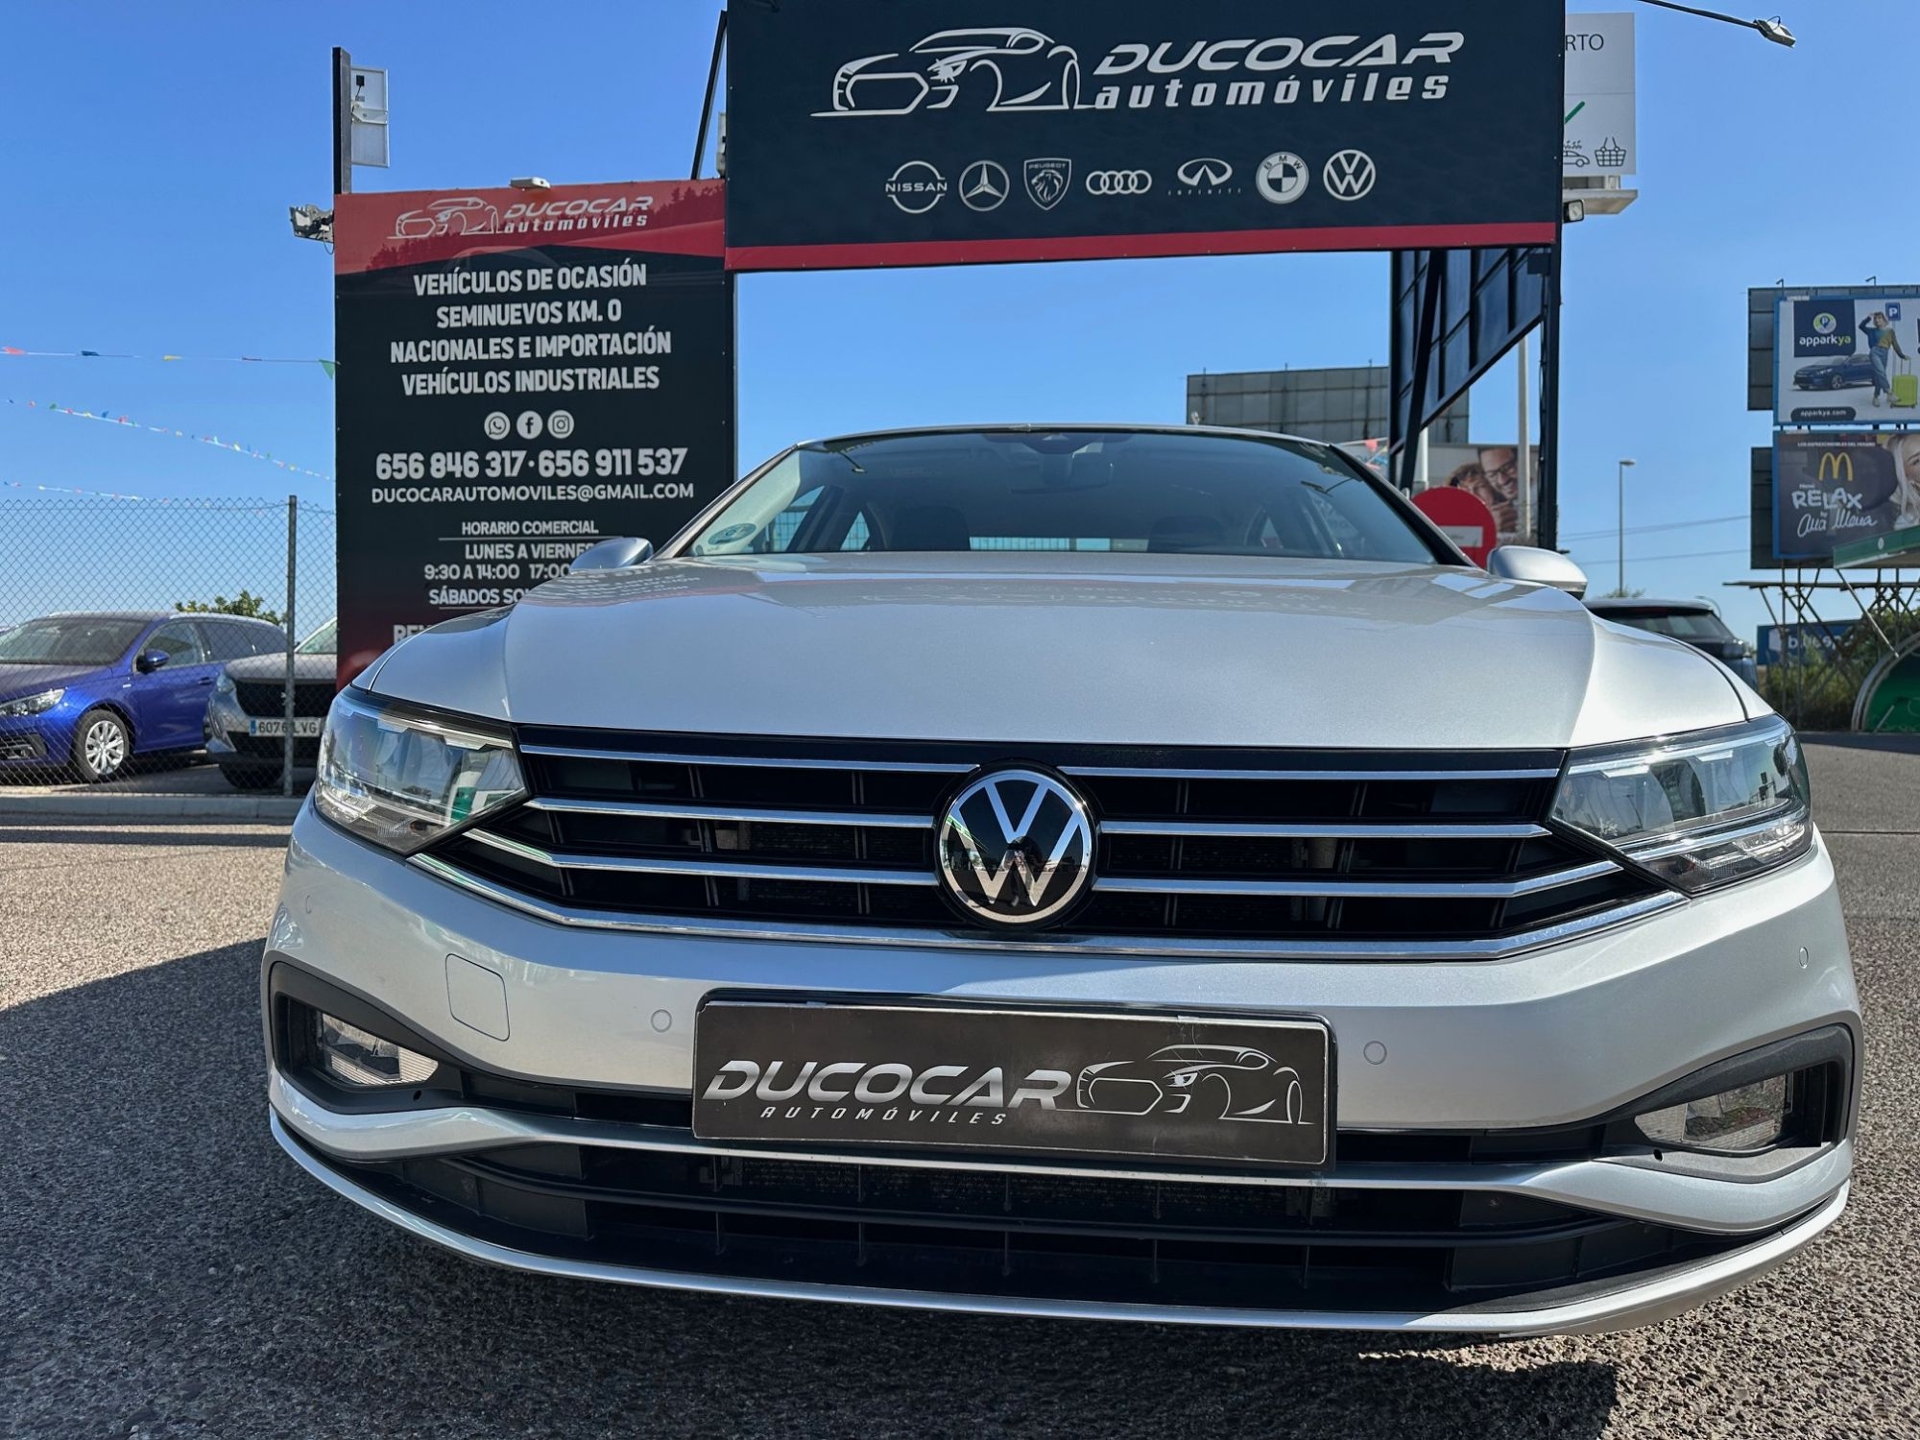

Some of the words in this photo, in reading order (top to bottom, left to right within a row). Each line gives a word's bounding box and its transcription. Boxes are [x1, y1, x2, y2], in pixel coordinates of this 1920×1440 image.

[1092, 31, 1466, 75] DUCOCAR
[1094, 72, 1450, 111] automóviles
[1028, 162, 1066, 170] PEUGEOT
[1263, 154, 1303, 171] BMW
[885, 181, 948, 193] NISSAN
[503, 195, 654, 220] DUCOCAR
[504, 214, 648, 234] automóviles
[413, 266, 523, 297] VEHÍCULOS
[527, 269, 554, 292] DE
[557, 257, 648, 290] OCASIÓN
[436, 302, 564, 329] SEMINUEVOS
[567, 301, 604, 323] KM.
[390, 336, 516, 364] NACIONALES
[518, 336, 532, 359] E
[535, 325, 672, 358] IMPORTACIÓN
[1799, 335, 1852, 347] apparkya
[401, 365, 512, 396] VEHÍCULOS
[515, 365, 660, 393] INDUSTRIALES
[375, 452, 425, 480] 656
[429, 450, 480, 479] 846
[595, 448, 632, 477] 911
[637, 447, 688, 476] 537
[371, 482, 695, 504] DUCOCARAUTOMOVILES@GMAIL.COM
[1791, 488, 1863, 510] RELAX
[461, 521, 520, 536] HORARIO
[521, 520, 600, 536] COMERCIAL
[464, 543, 515, 560] LUNES
[516, 543, 529, 559] A
[424, 564, 461, 580] 9:30
[462, 564, 474, 580] A
[475, 563, 520, 580] 14:00
[528, 563, 571, 580] 17:00
[428, 584, 501, 605] SÁBADOS
[503, 587, 530, 604] SO
[258, 721, 288, 733] 6076
[702, 1059, 1074, 1110] DUCOCAR
[760, 1105, 1009, 1126] AUTOMÓVILES
